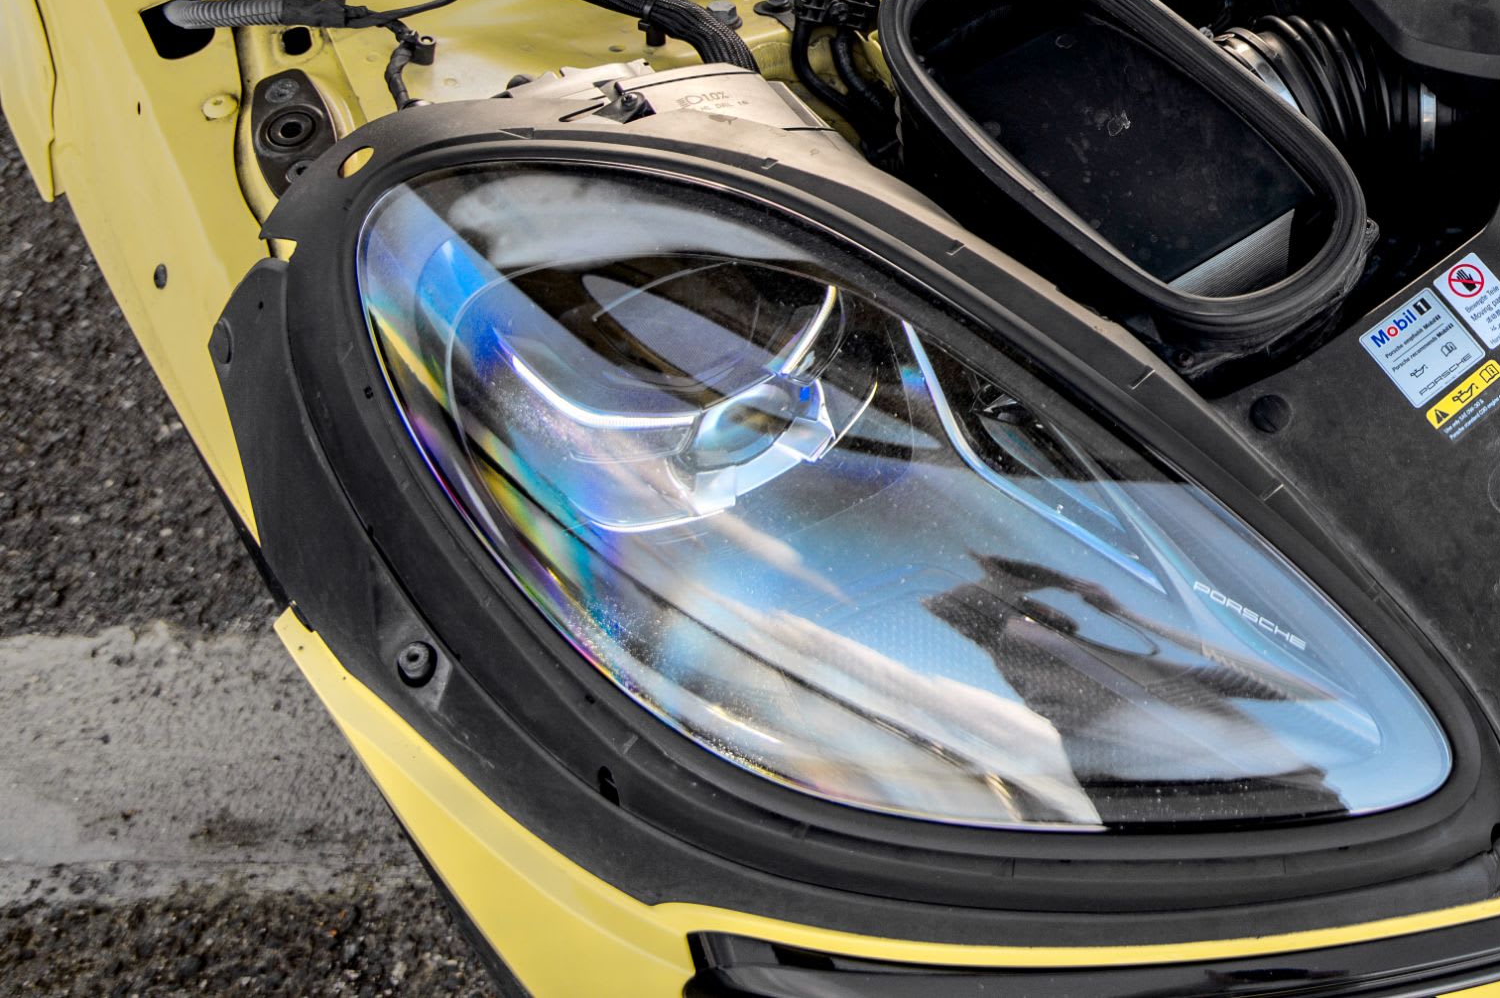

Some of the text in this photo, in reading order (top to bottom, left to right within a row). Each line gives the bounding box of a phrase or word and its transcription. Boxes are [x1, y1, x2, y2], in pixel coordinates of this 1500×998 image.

[1465, 286, 1500, 313] Bewegte Teile
[1470, 304, 1493, 321] Moving
[1371, 309, 1417, 348] Mobil
[1385, 344, 1404, 358] Porsche
[1392, 358, 1410, 372] Porsche
[1419, 353, 1472, 395] PORSCHE
[1193, 580, 1307, 651] PORSCHE
